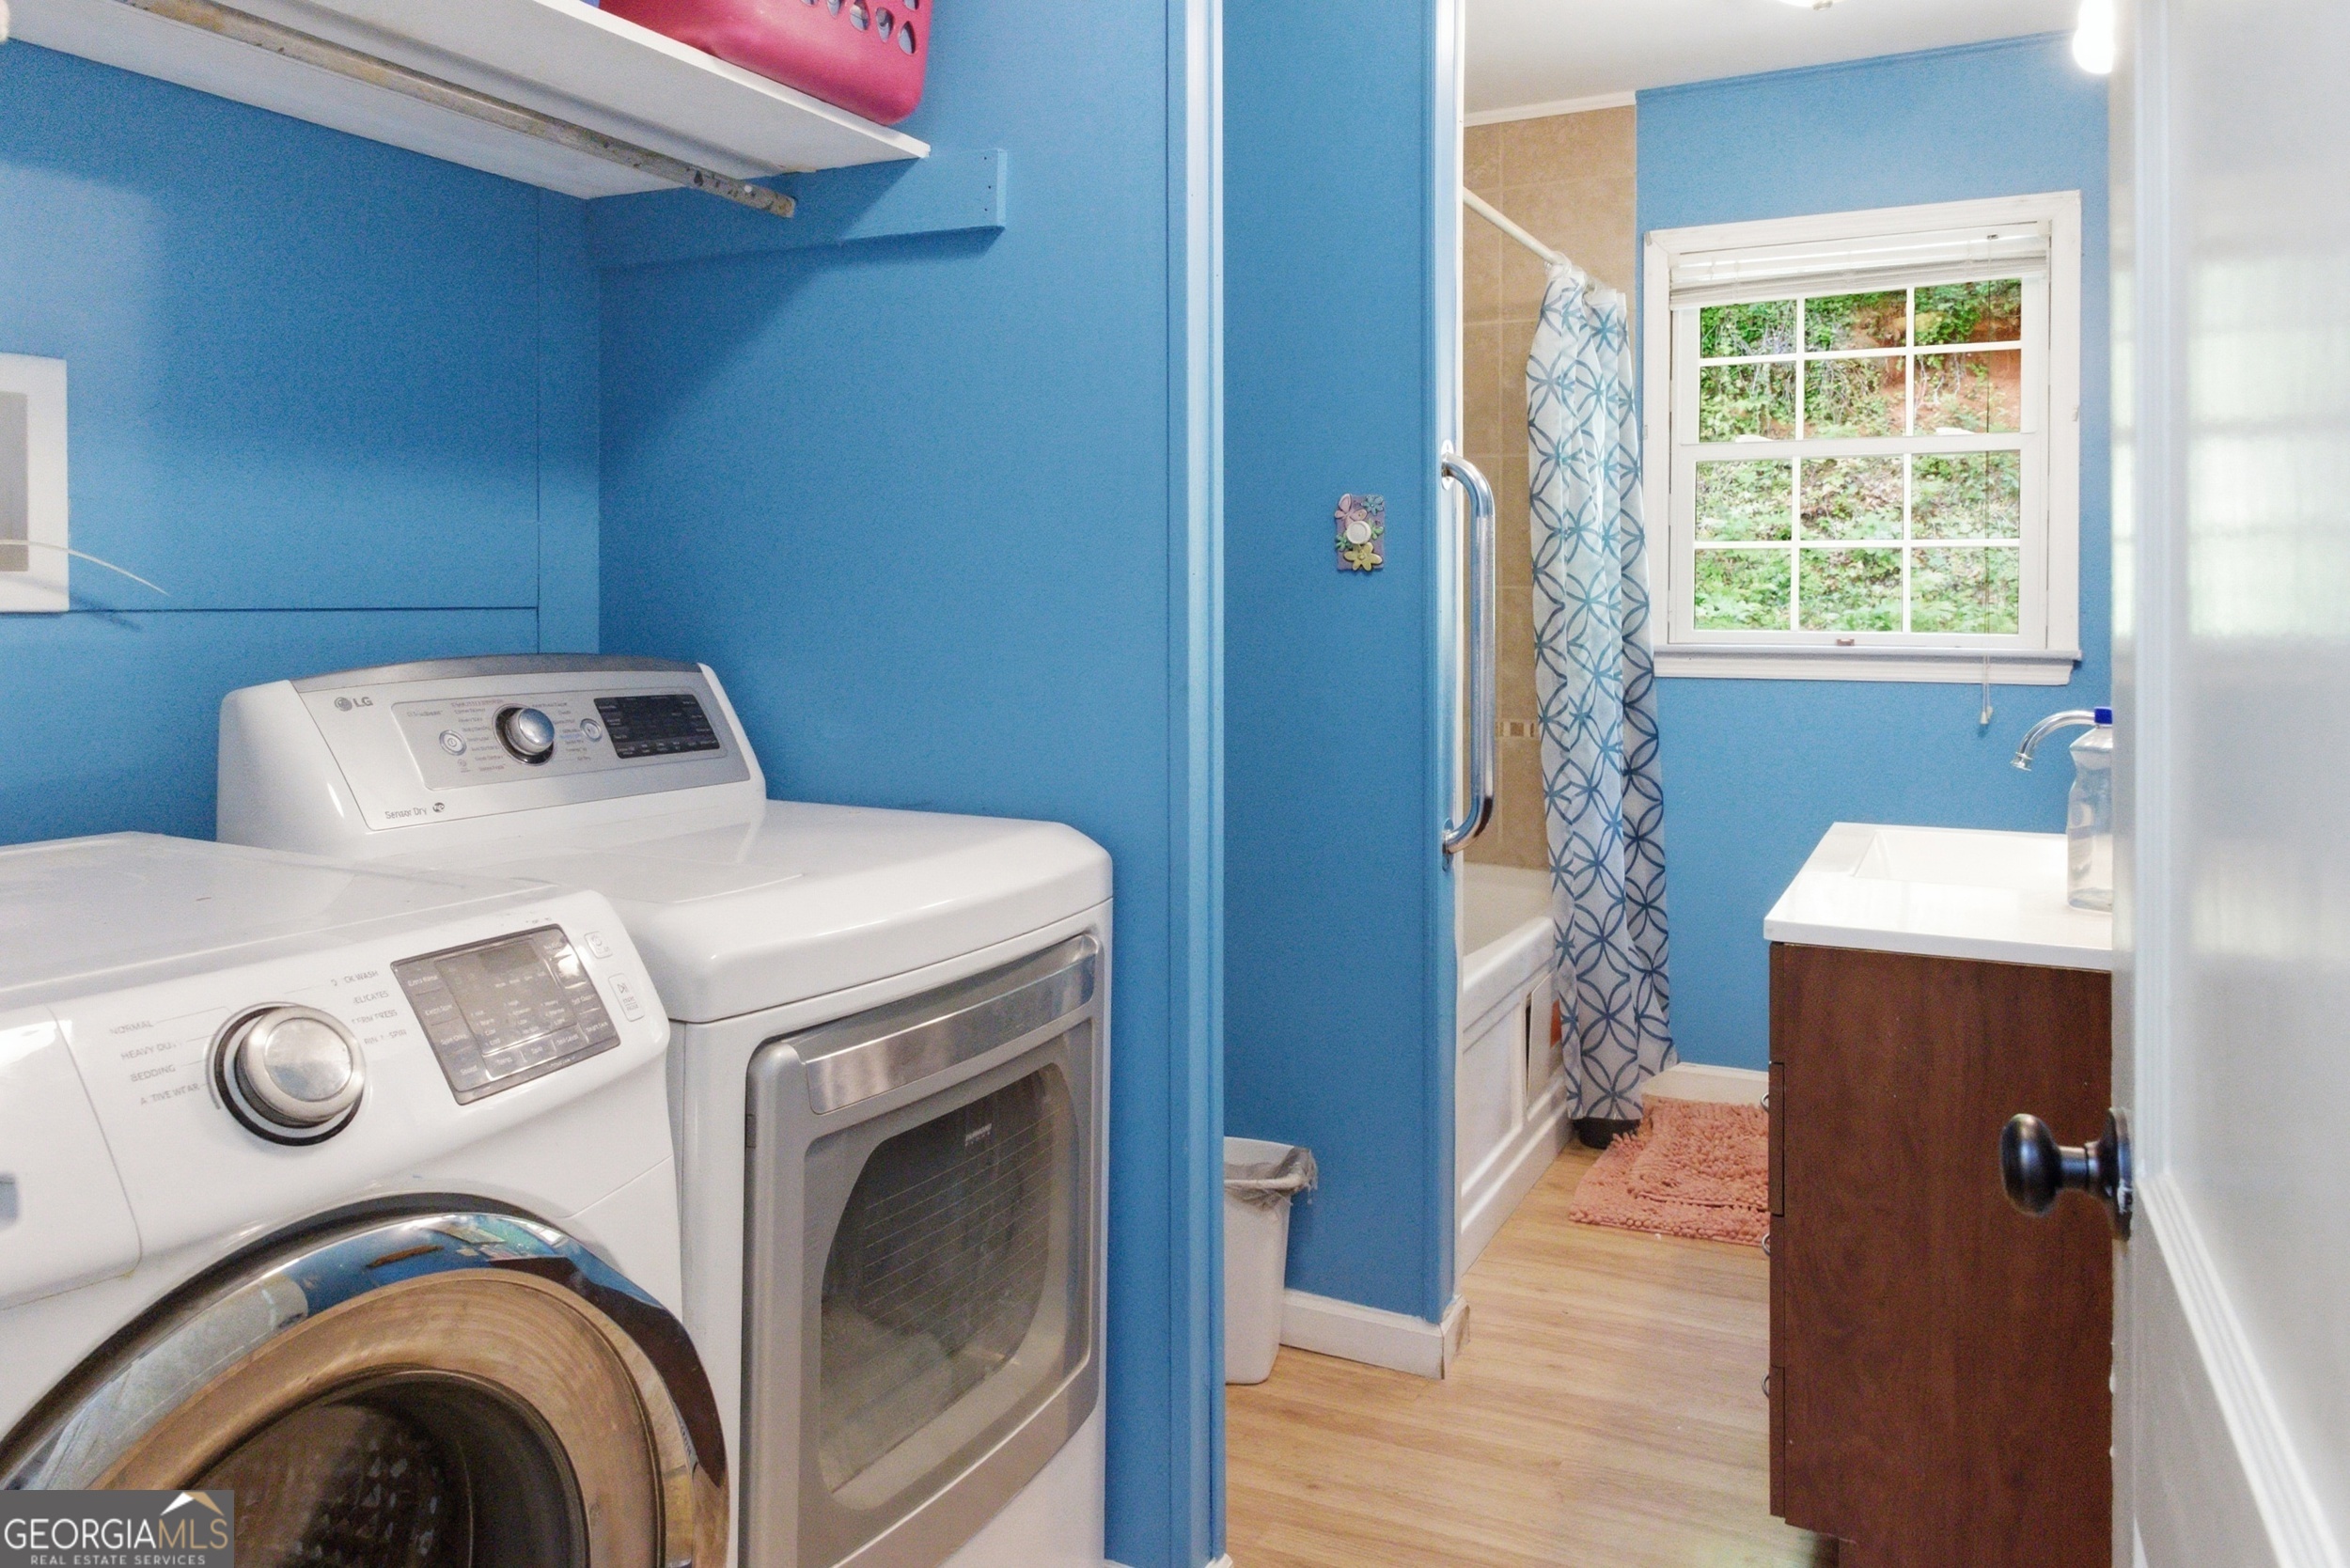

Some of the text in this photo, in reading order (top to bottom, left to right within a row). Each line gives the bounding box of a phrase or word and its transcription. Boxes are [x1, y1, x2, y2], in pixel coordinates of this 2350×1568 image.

[352, 697, 373, 708] LG
[384, 807, 428, 820] Sensor Dry
[355, 970, 379, 981] WASH
[109, 1020, 154, 1035] NORMAL
[120, 1045, 154, 1060] HEAVY
[131, 1064, 176, 1082] BEDDING
[140, 1090, 172, 1105] ATIVE
